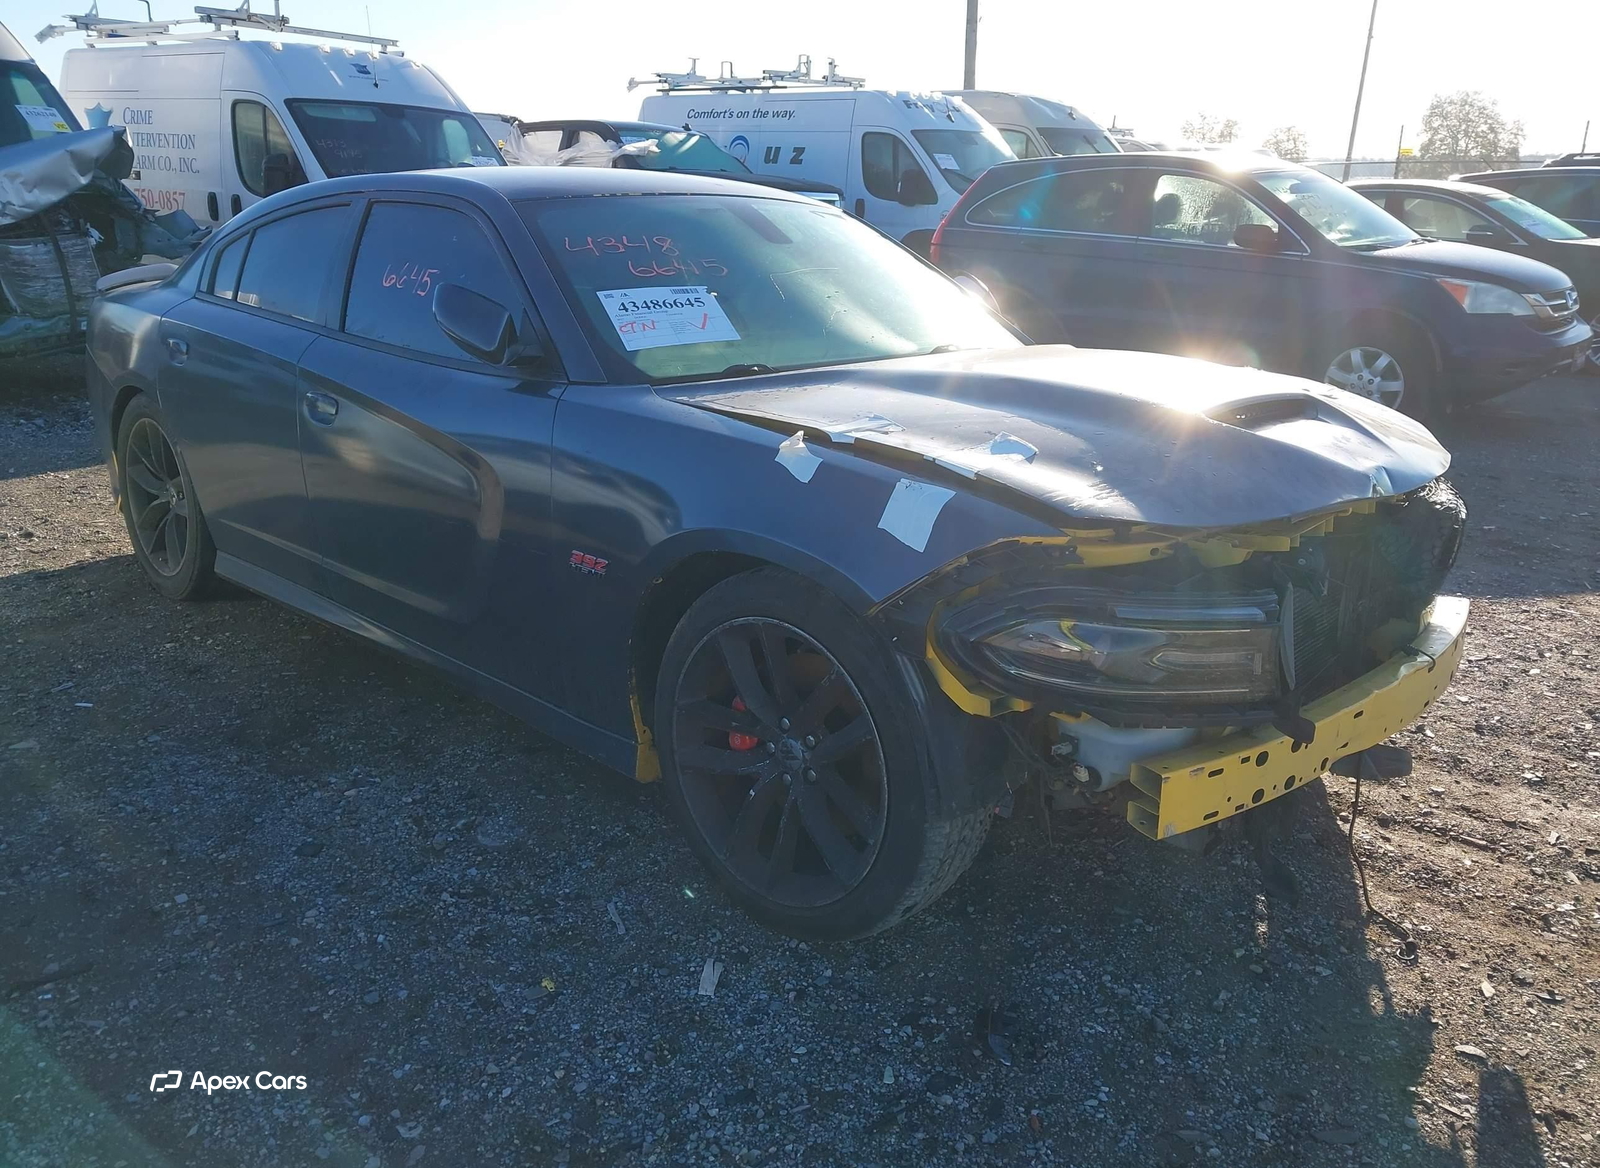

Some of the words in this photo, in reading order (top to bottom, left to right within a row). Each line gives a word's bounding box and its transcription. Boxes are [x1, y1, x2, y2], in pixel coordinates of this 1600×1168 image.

[686, 108, 734, 119] Comfort's
[736, 110, 749, 119] on
[752, 108, 769, 119] the
[771, 109, 796, 120] way.
[132, 131, 196, 150] TERVENTION
[179, 157, 200, 174] INC.
[564, 235, 679, 257] 4348
[617, 297, 706, 313] 43486645
[569, 549, 609, 573] 392
